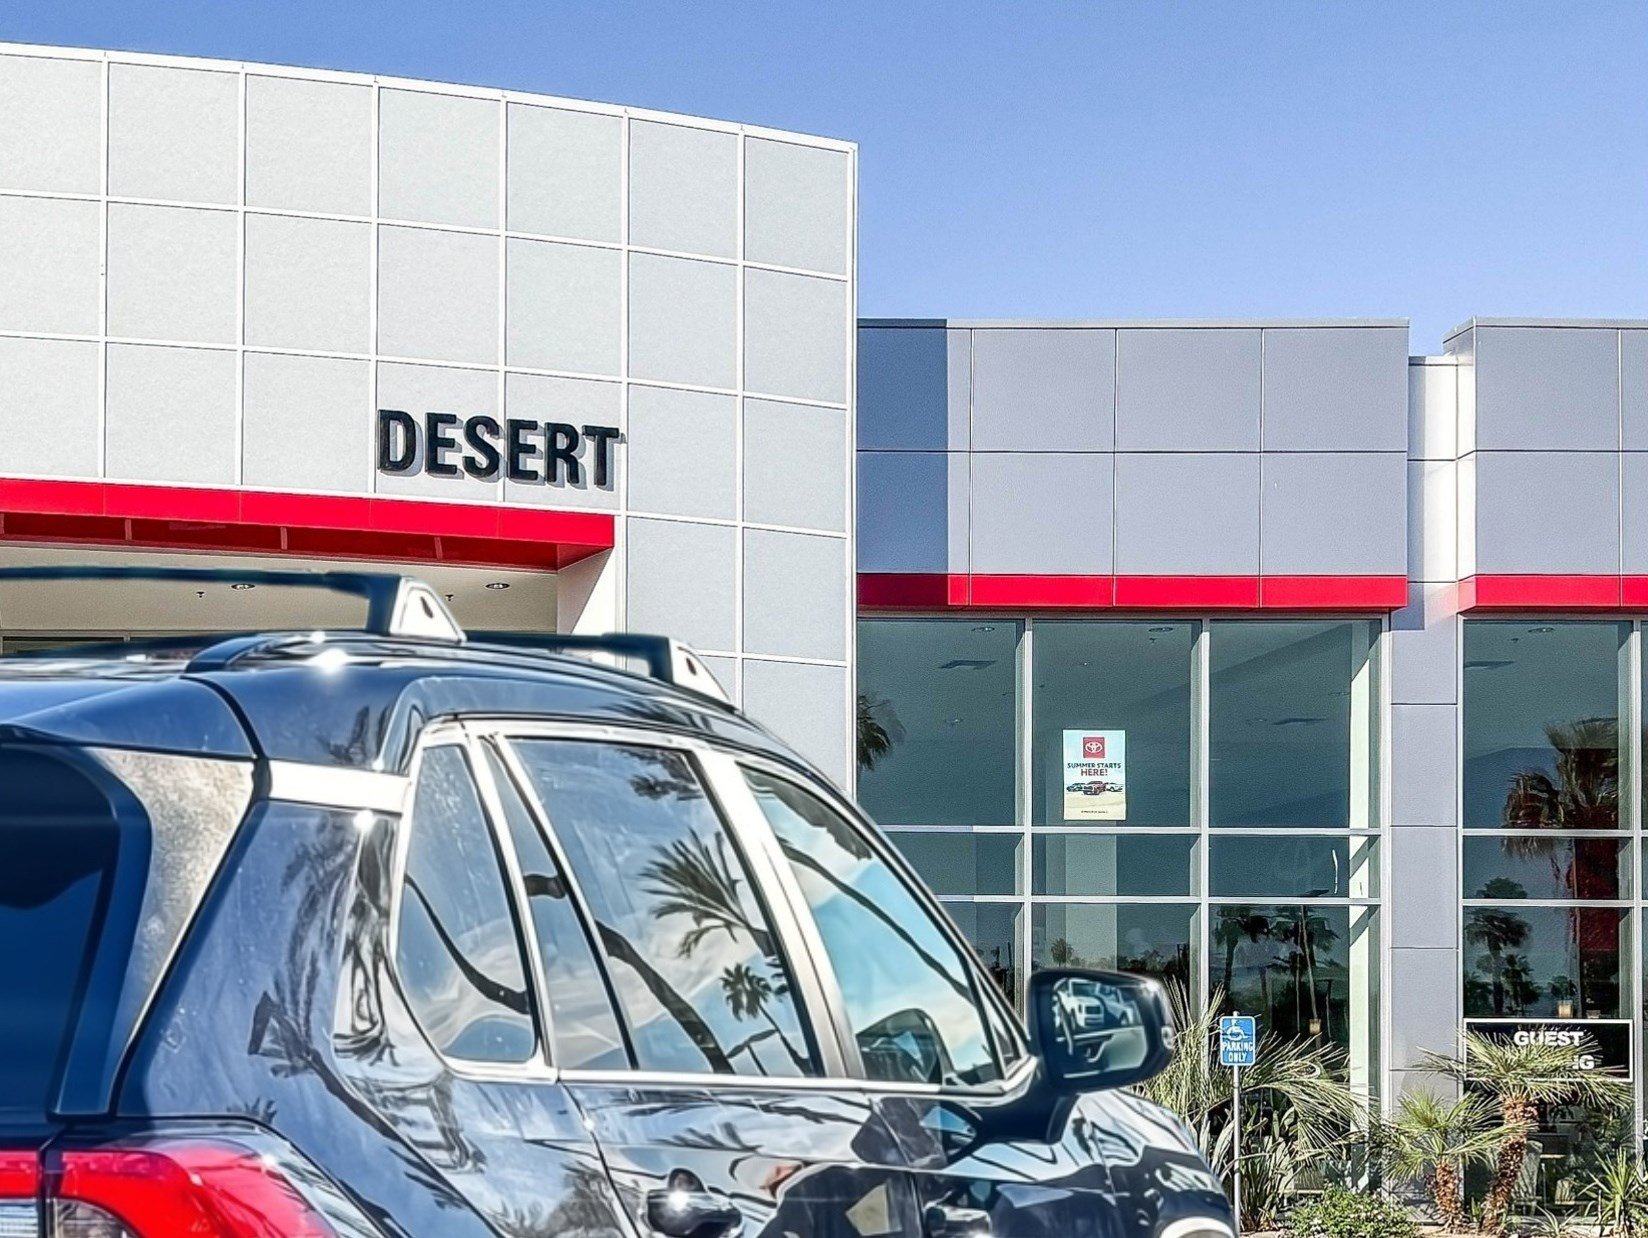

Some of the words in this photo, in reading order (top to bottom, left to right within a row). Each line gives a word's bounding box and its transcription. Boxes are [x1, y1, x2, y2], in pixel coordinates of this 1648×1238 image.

[377, 409, 620, 487] DESERT
[1080, 768, 1108, 777] HERE!
[1513, 1031, 1585, 1048] GUEST
[1222, 1041, 1254, 1052] PARKING
[1228, 1051, 1248, 1063] ONLY
